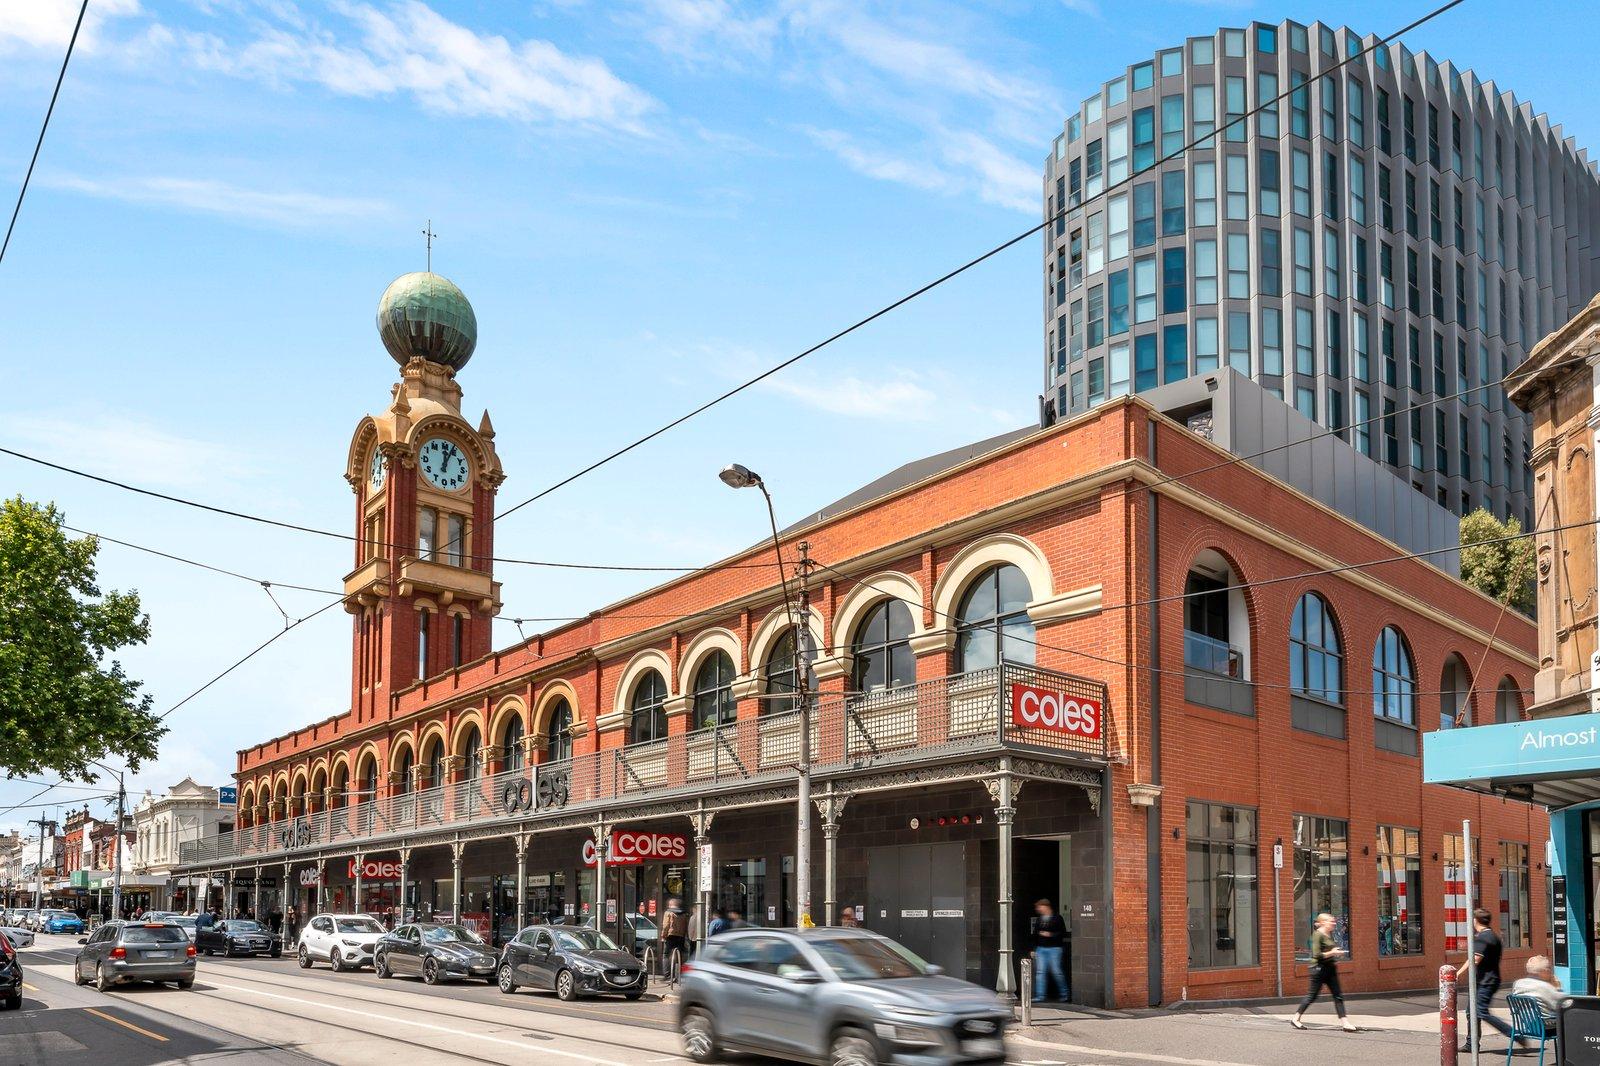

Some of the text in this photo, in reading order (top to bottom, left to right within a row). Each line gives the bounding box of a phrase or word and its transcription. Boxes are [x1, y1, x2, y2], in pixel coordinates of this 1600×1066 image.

[426, 466, 463, 487] STORE
[1020, 691, 1096, 734] coles
[1520, 727, 1597, 750] Almost
[221, 791, 228, 799] P
[618, 834, 686, 857] coles
[300, 867, 320, 885] cole
[351, 862, 403, 877] coles
